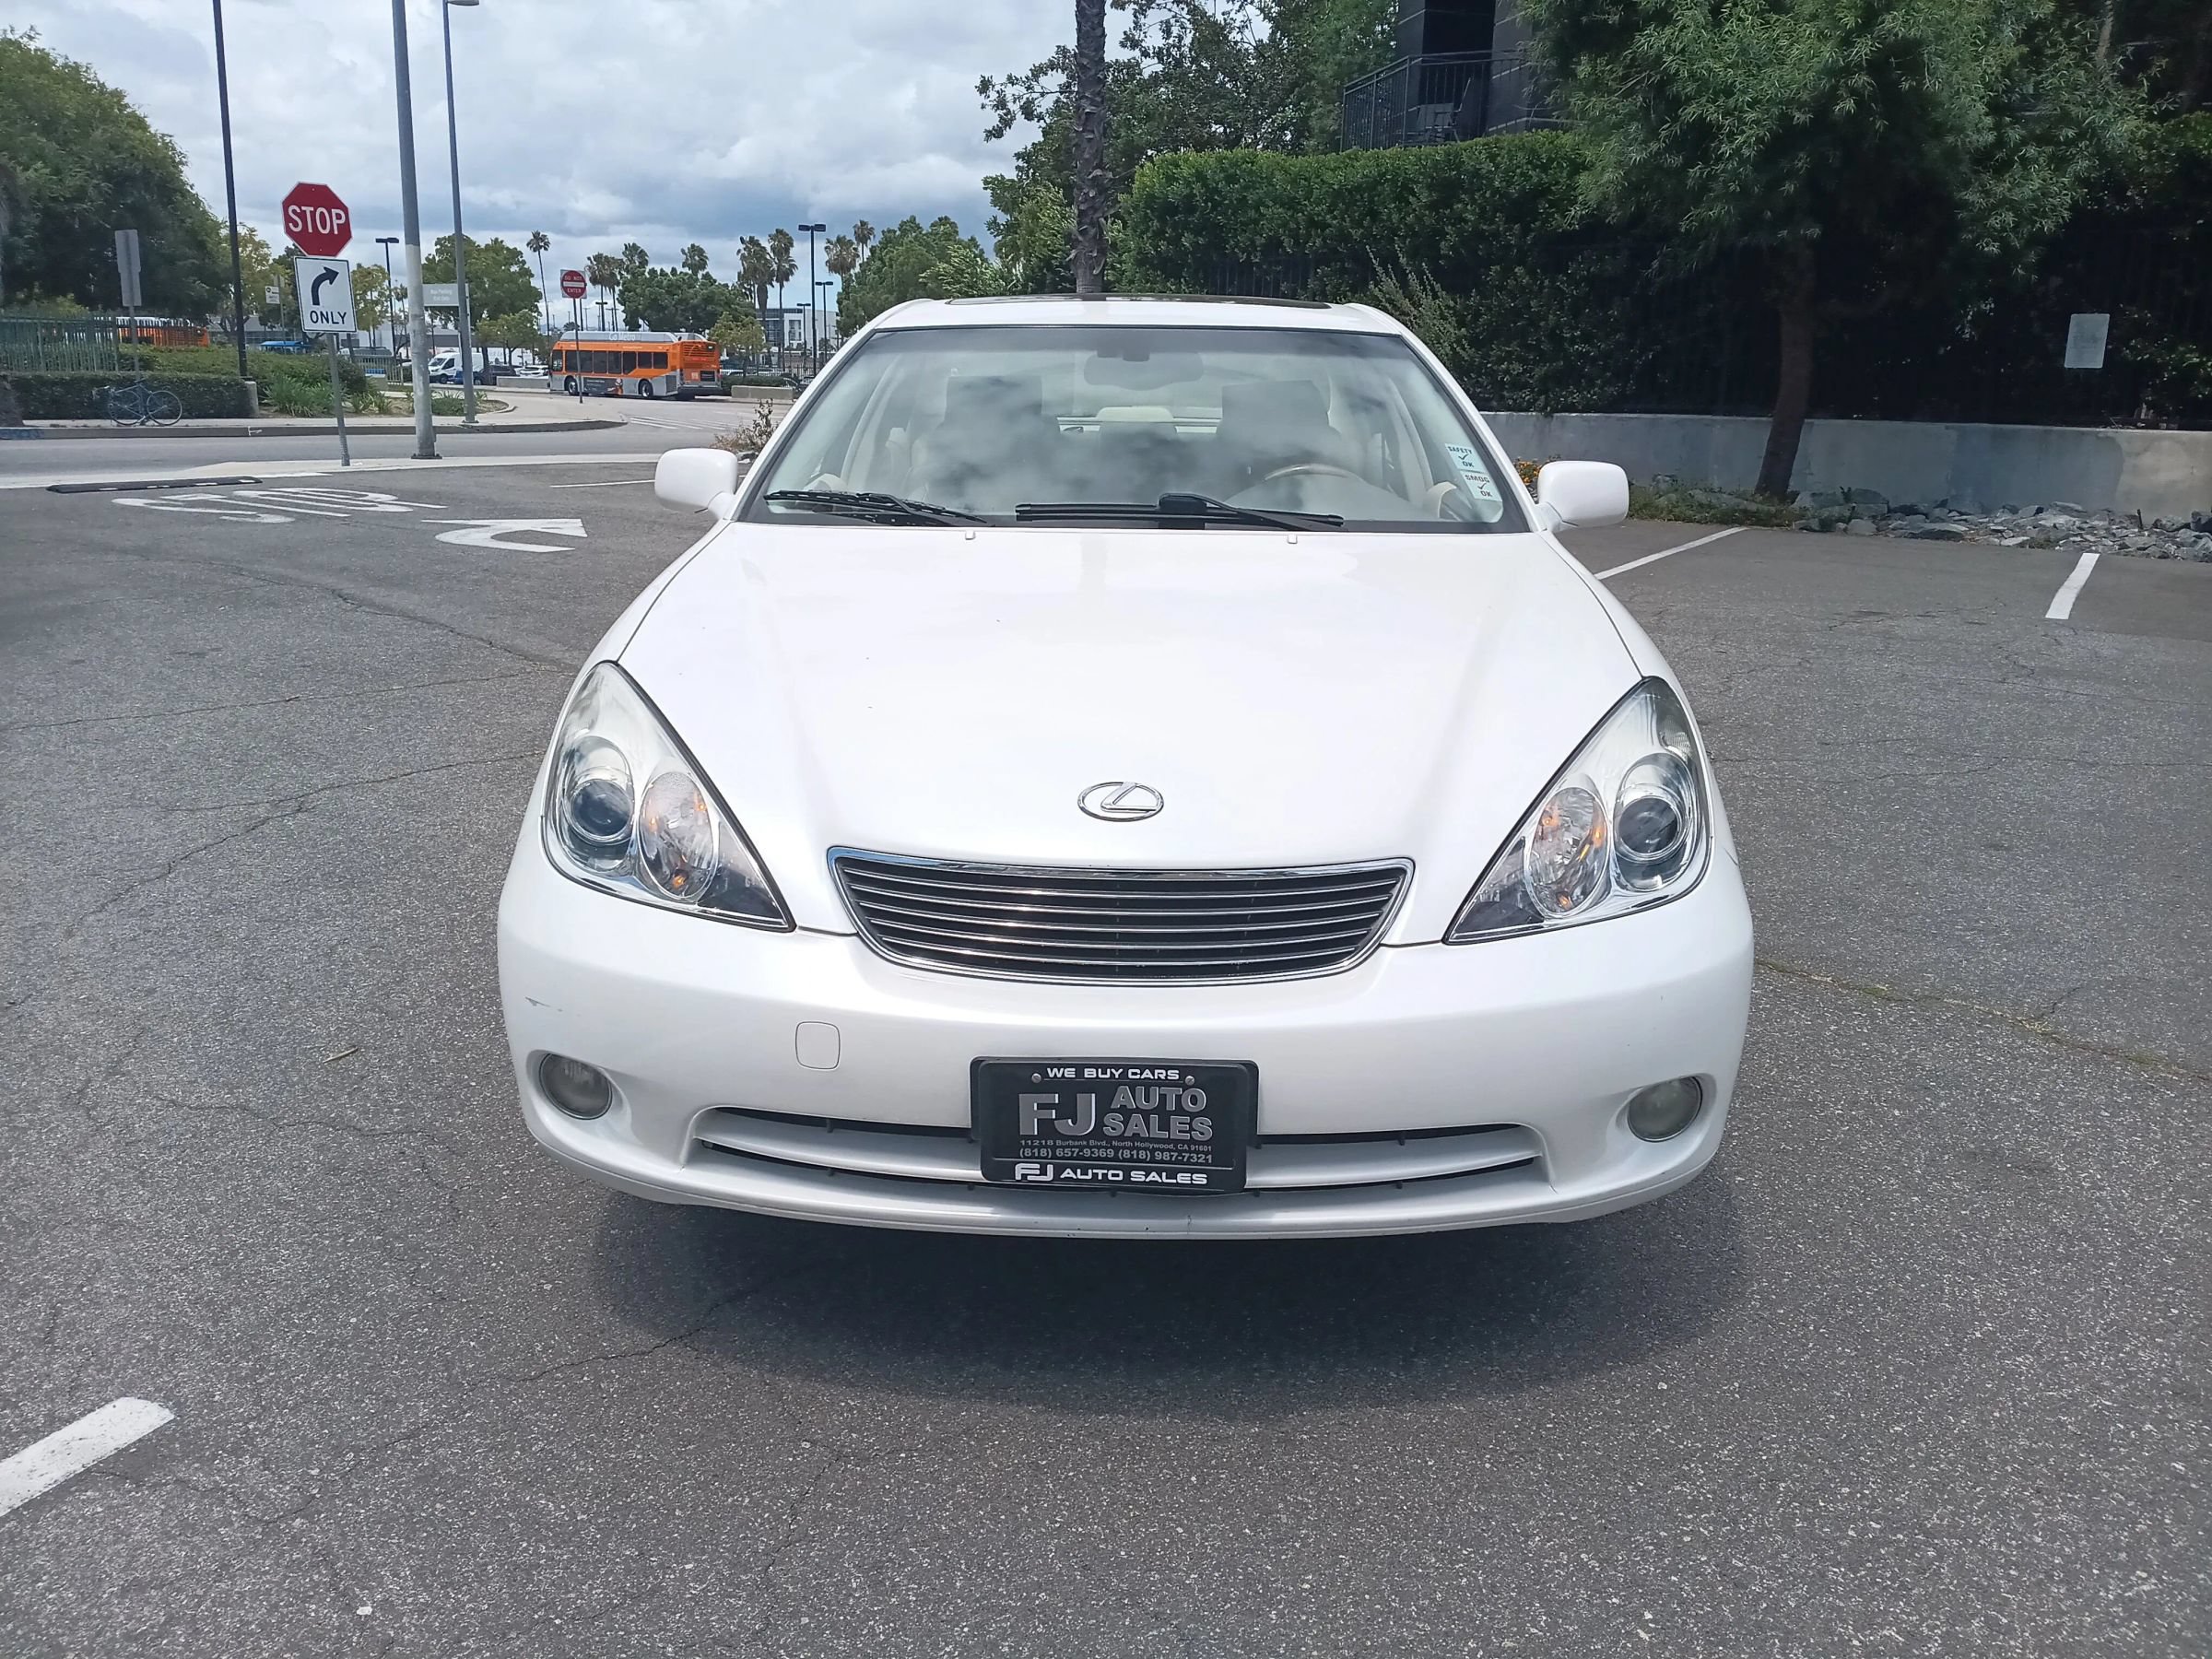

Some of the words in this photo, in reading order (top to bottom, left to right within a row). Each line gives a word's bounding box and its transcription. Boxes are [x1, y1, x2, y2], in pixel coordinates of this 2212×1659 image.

[288, 205, 346, 234] STOP
[310, 310, 347, 324] ONLY
[1448, 446, 1472, 454] SAFETY
[1465, 475, 1490, 483] SMOG
[1046, 1067, 1076, 1078] WE
[1084, 1067, 1124, 1079] BUY
[1127, 1068, 1180, 1080] CARS
[1111, 1086, 1206, 1112] AUTO
[1018, 1093, 1096, 1135] FJ
[1102, 1112, 1213, 1141] SALES
[1135, 1141, 1176, 1150] Hollywood,
[1019, 1147, 1053, 1159] (818)
[1055, 1147, 1115, 1158] 657-9369
[1118, 1148, 1151, 1161] (818)
[1154, 1150, 1213, 1163] 987-7321
[1015, 1163, 1054, 1182] FJ
[1060, 1168, 1124, 1181] AUTO
[1130, 1171, 1207, 1184] SALES
